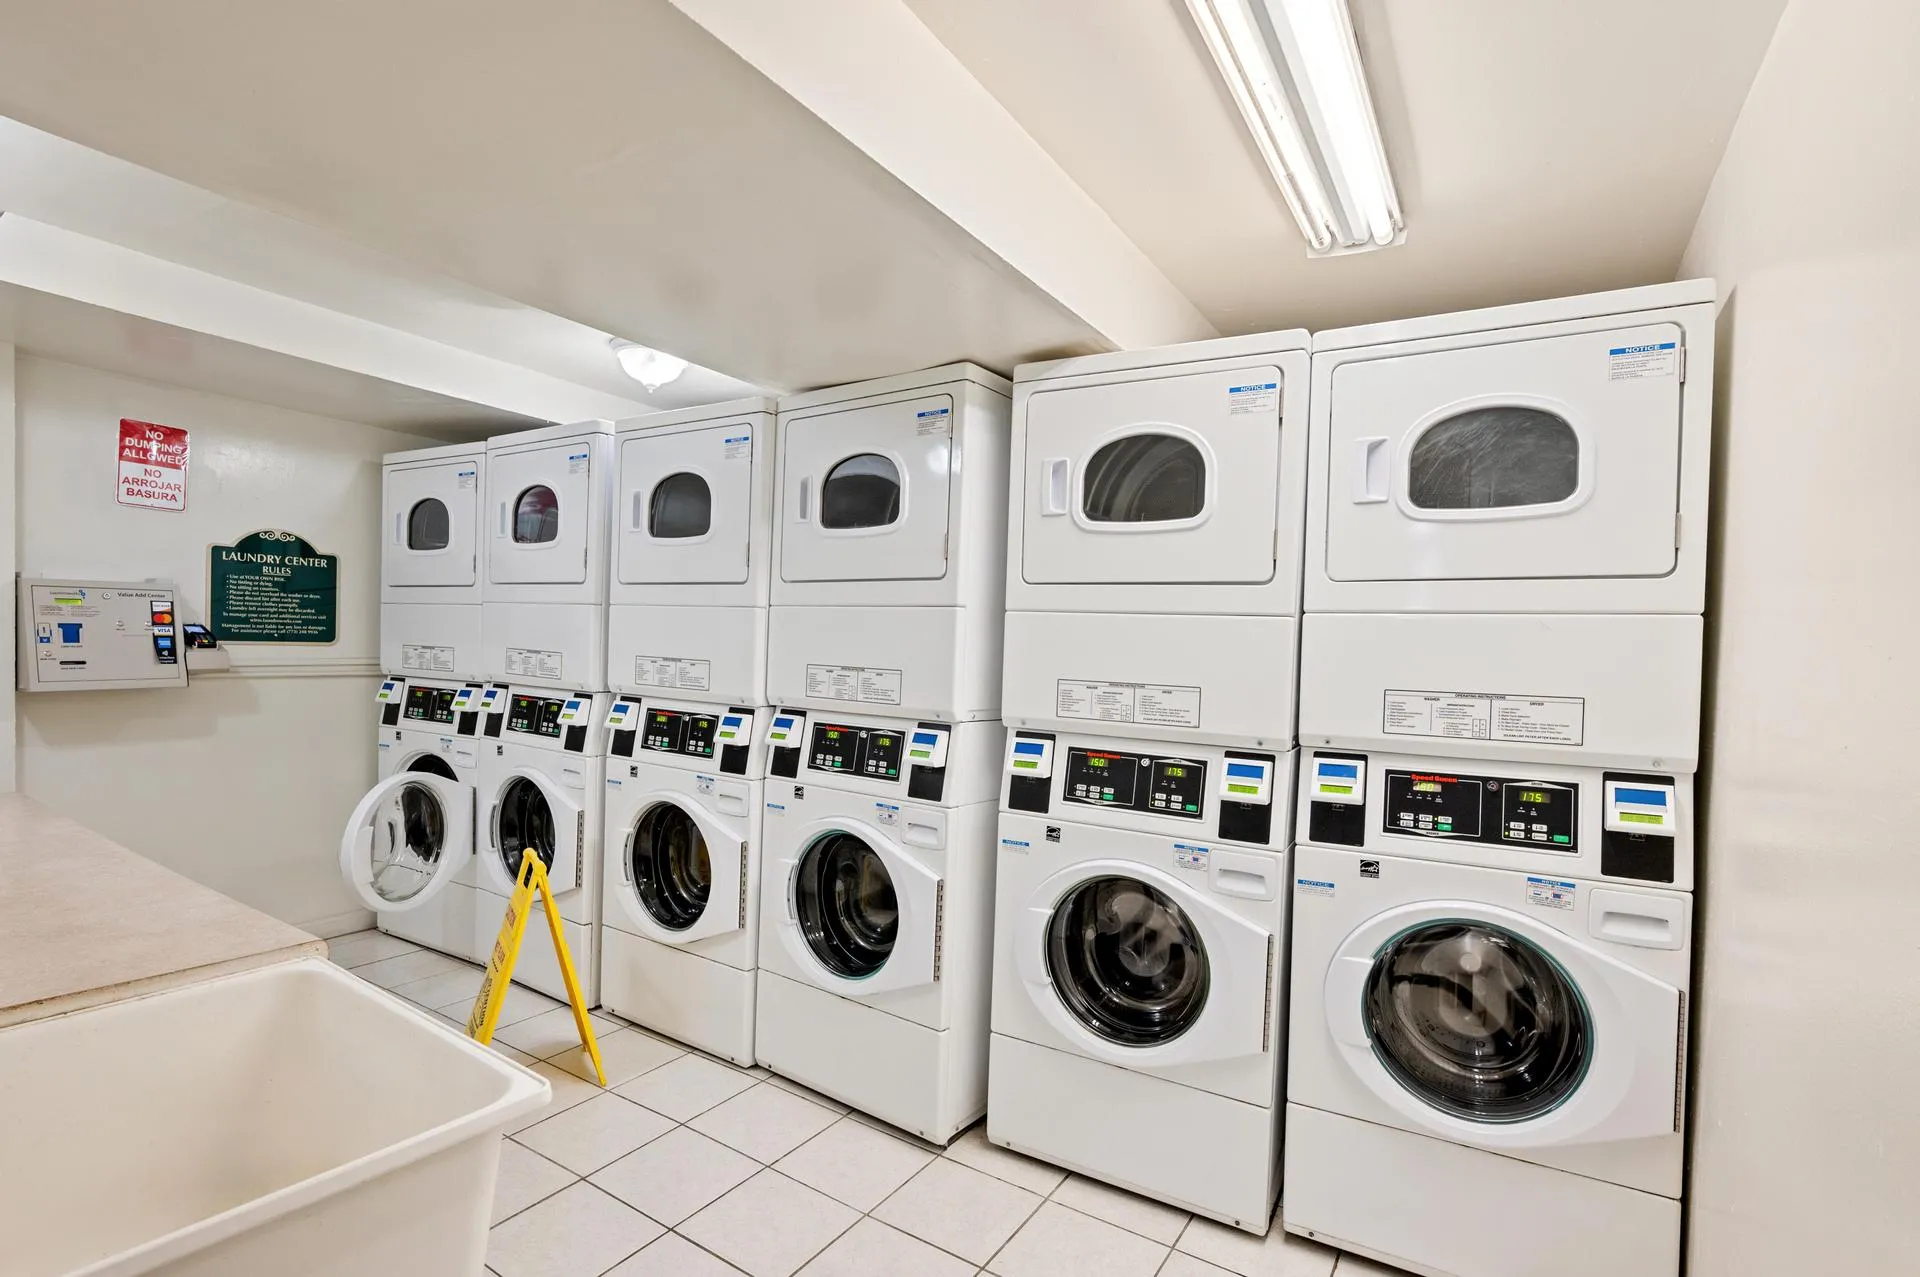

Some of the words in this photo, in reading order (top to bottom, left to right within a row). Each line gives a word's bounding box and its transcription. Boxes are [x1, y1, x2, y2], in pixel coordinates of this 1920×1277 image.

[1626, 344, 1660, 354] NOTICE
[146, 430, 164, 440] NO
[126, 437, 182, 454] DUMPING
[122, 448, 183, 465] ALLOWED
[144, 468, 162, 478] NO
[122, 476, 182, 492] ARROJAR
[126, 487, 178, 502] BASURA
[222, 551, 281, 564] LAUNDRY
[285, 556, 328, 568] CENTER
[262, 566, 291, 575] RULES
[1090, 758, 1104, 766] 150
[1168, 768, 1182, 776] 175
[1523, 792, 1542, 802] 175
